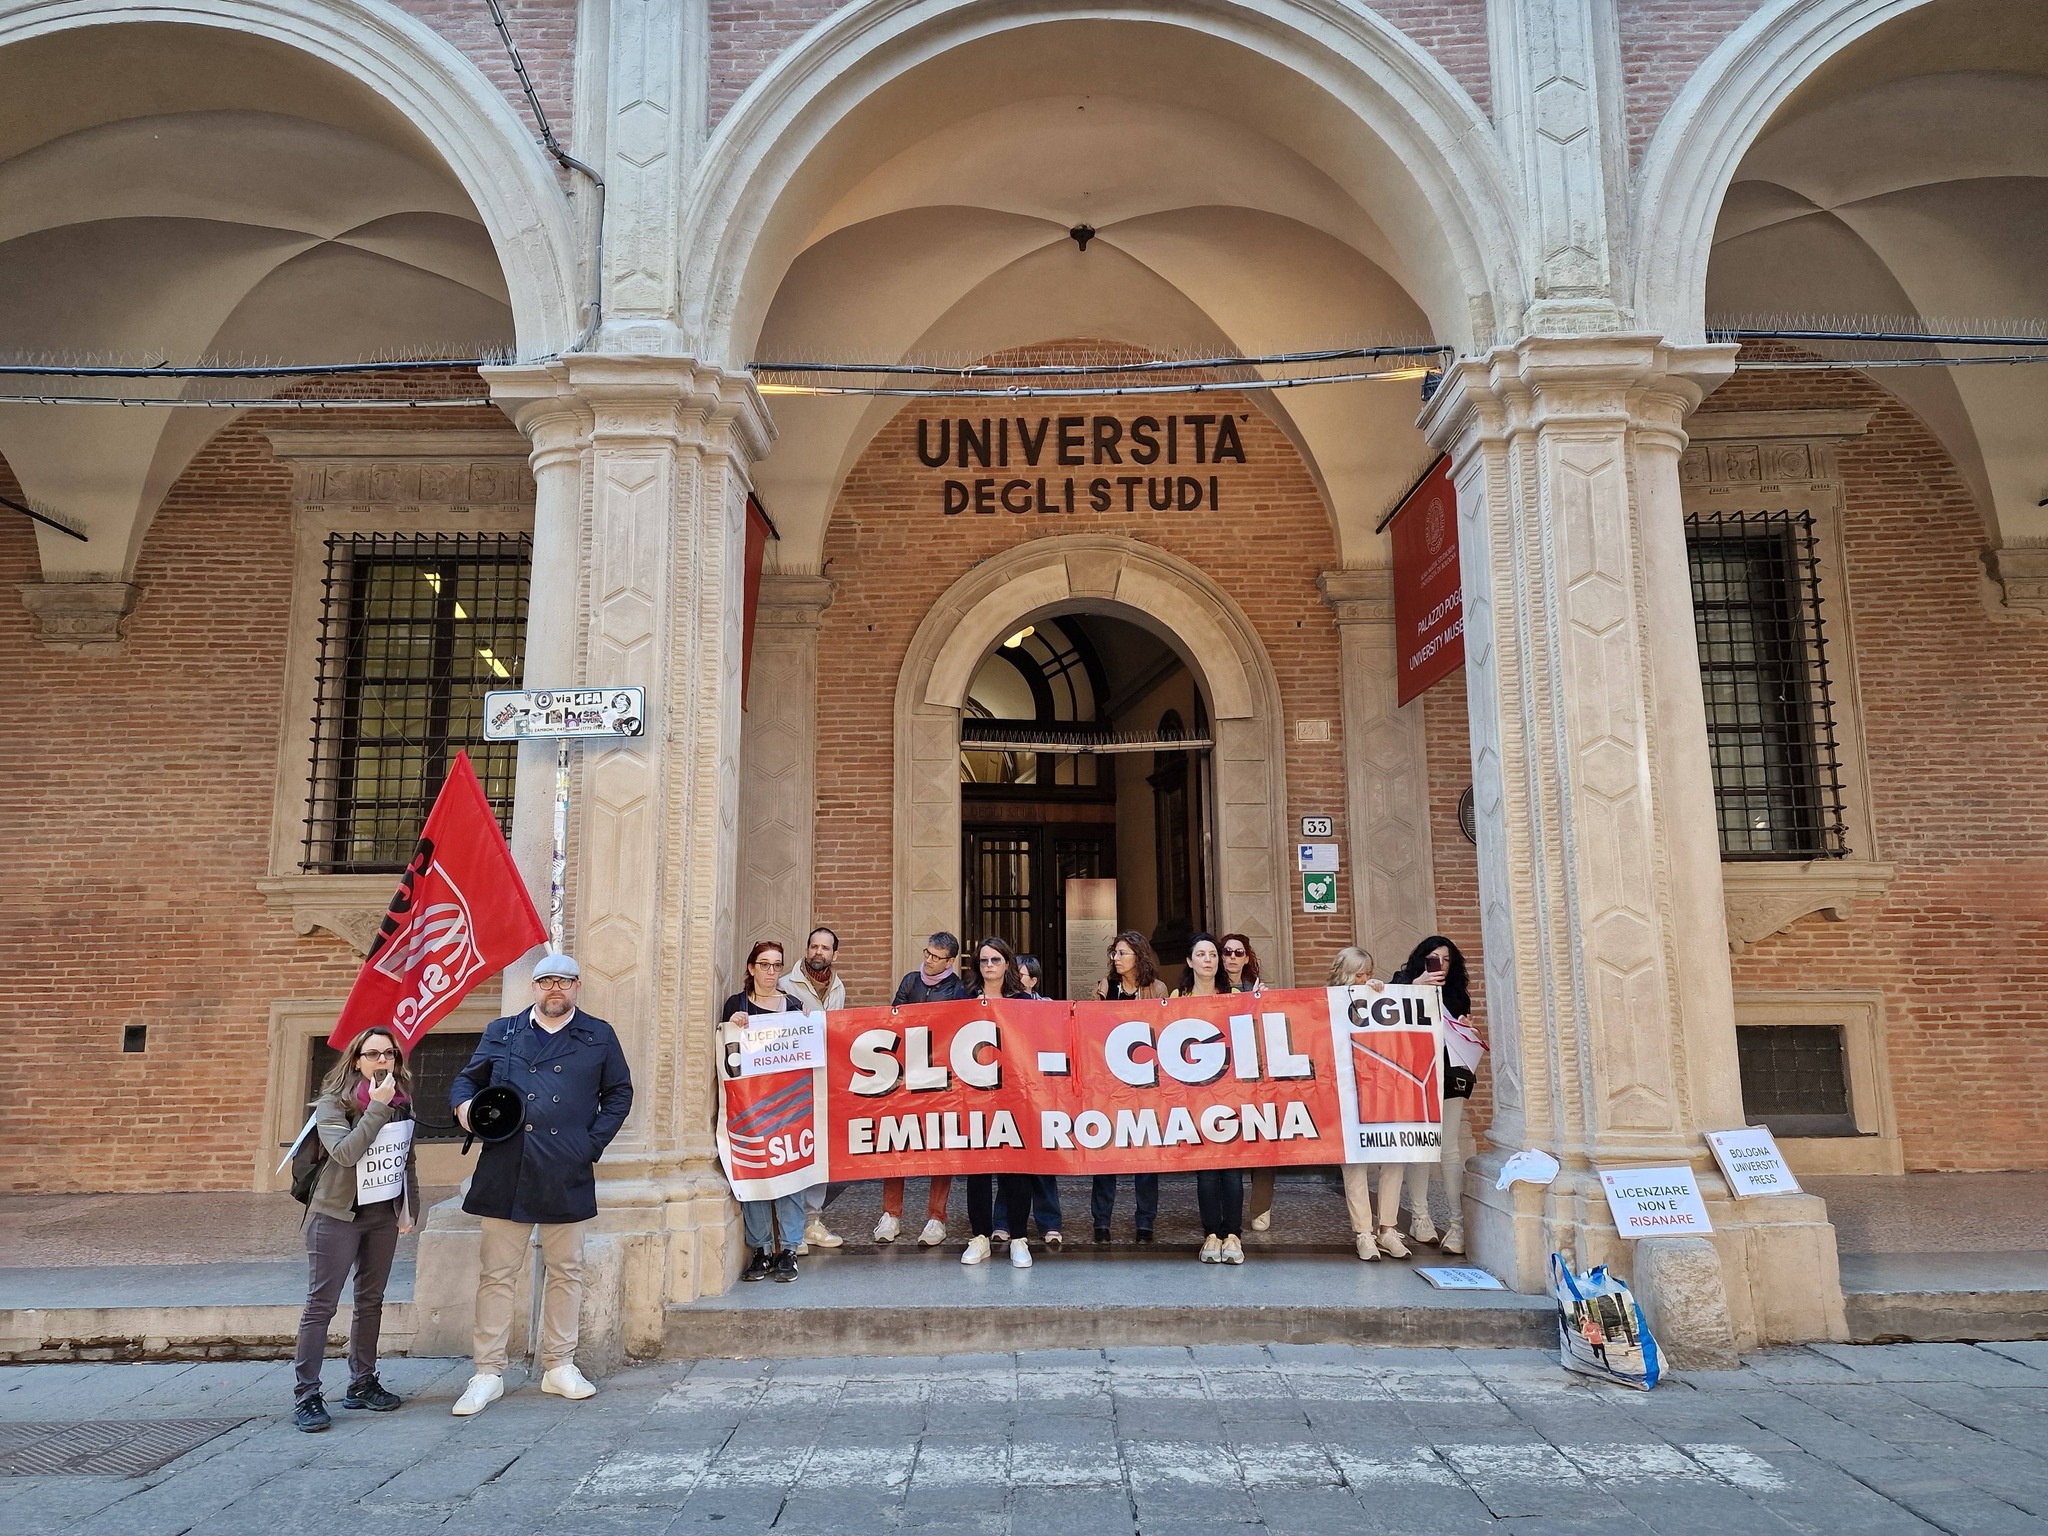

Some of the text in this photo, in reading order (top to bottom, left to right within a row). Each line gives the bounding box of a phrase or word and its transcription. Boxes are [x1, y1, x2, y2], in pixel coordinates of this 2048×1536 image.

[944, 475, 1219, 515] DEGLI STUDI
[1417, 586, 1463, 637] PALAZZO POGG
[1409, 617, 1464, 671] UNIVERSITY MUSE
[556, 694, 571, 703] via
[1307, 821, 1327, 834] 33
[1348, 997, 1432, 1027] CGIL
[747, 1025, 814, 1042] LICENZIARE
[764, 1038, 800, 1053] NON È
[753, 1051, 812, 1067] RISANARE
[849, 1020, 1001, 1096] SLC
[1105, 1012, 1313, 1086] CGIL
[849, 1101, 1319, 1154] EMILIA ROMAGNA
[1359, 1132, 1397, 1147] EMILIA
[768, 1128, 814, 1167] SLC
[1729, 1146, 1770, 1158] BOLOGNA
[1732, 1160, 1780, 1172] UNIVERSITY
[362, 1178, 373, 1188] AI
[1749, 1173, 1778, 1185] PRESS
[1615, 1185, 1690, 1198] LICENZIARE
[1637, 1197, 1678, 1211] NON È
[1630, 1214, 1695, 1227] RISANARE
